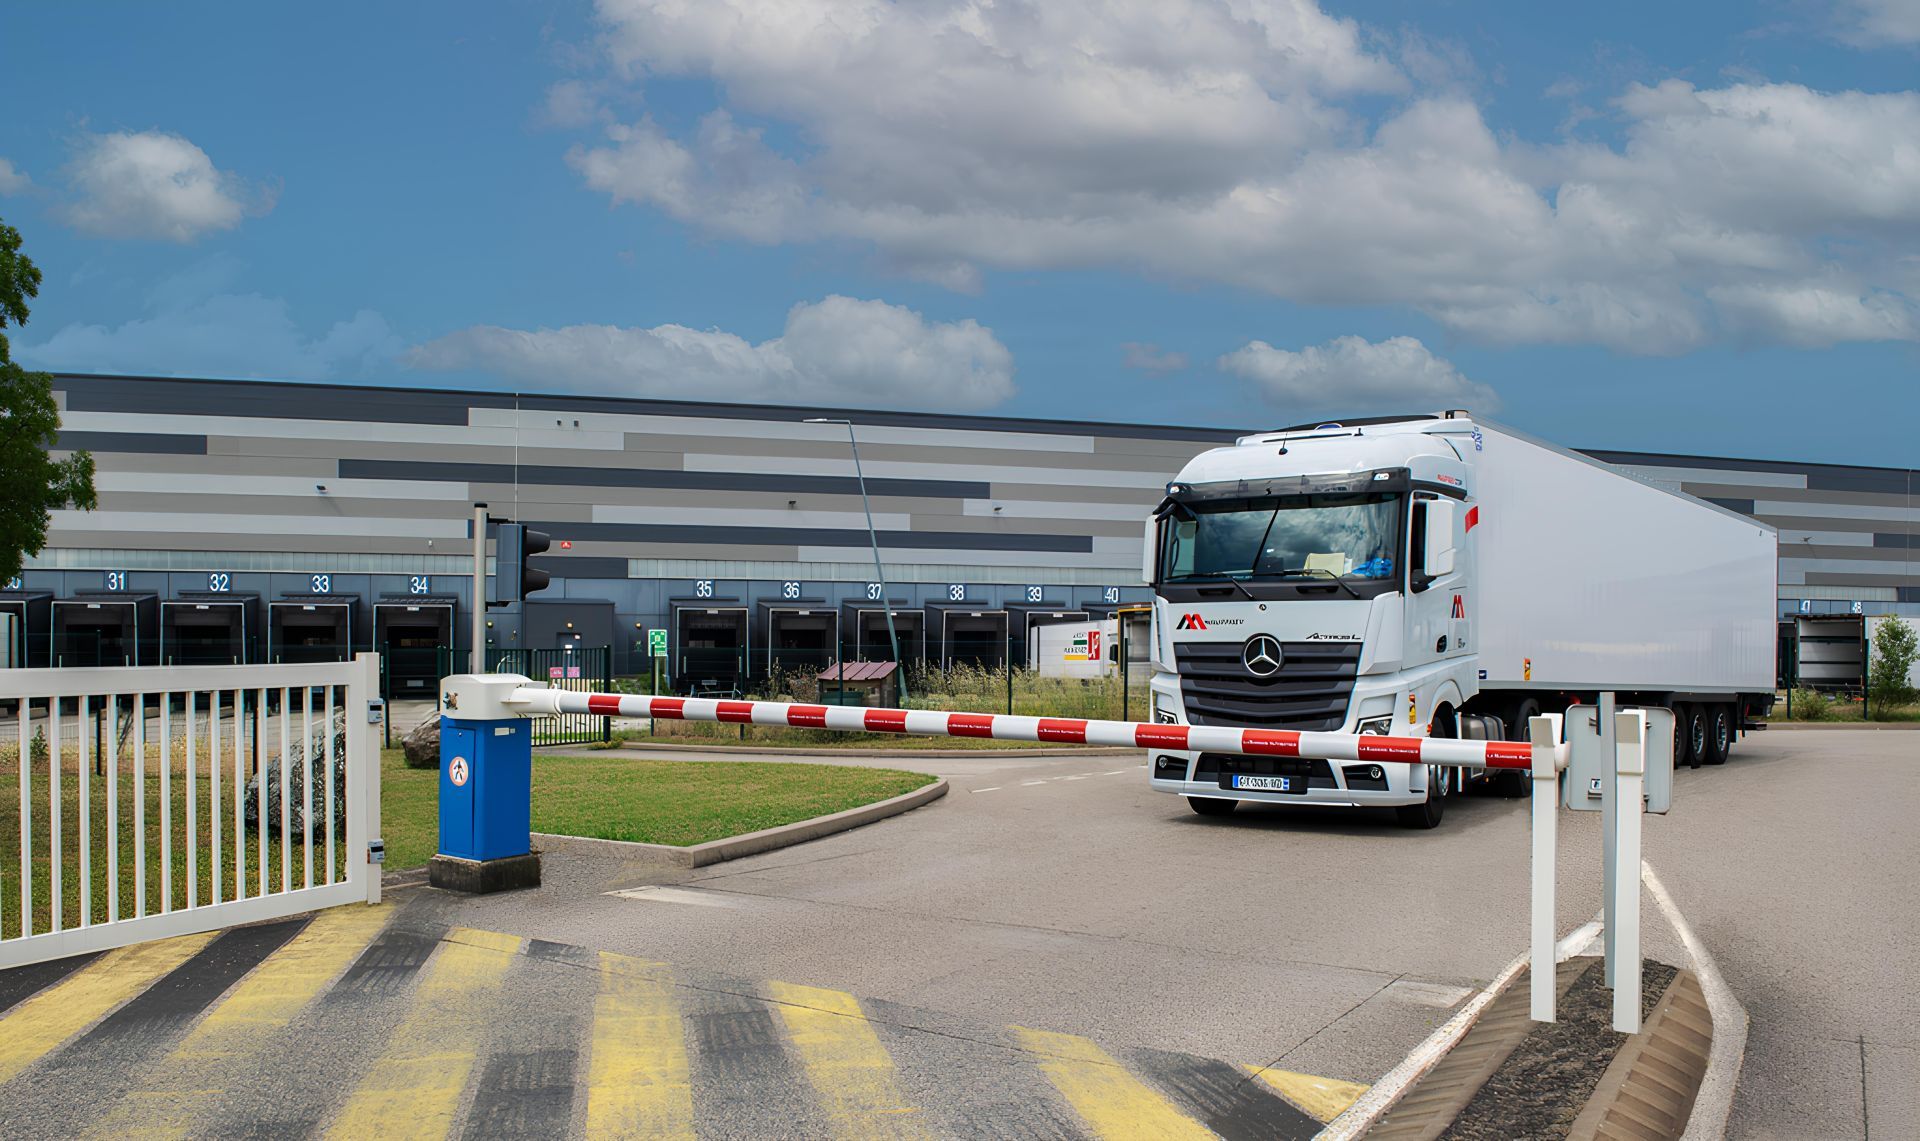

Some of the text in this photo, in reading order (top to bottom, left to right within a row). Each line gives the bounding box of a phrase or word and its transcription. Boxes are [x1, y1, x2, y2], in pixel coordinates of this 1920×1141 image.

[108, 572, 125, 590] 31
[210, 573, 229, 592] 32
[312, 574, 330, 593] 33
[411, 576, 428, 594] 34
[696, 580, 712, 598] 35
[784, 581, 800, 598] 36
[867, 583, 882, 599] 37
[950, 584, 964, 601] 38
[1028, 586, 1043, 602] 39
[1104, 586, 1119, 603] 40
